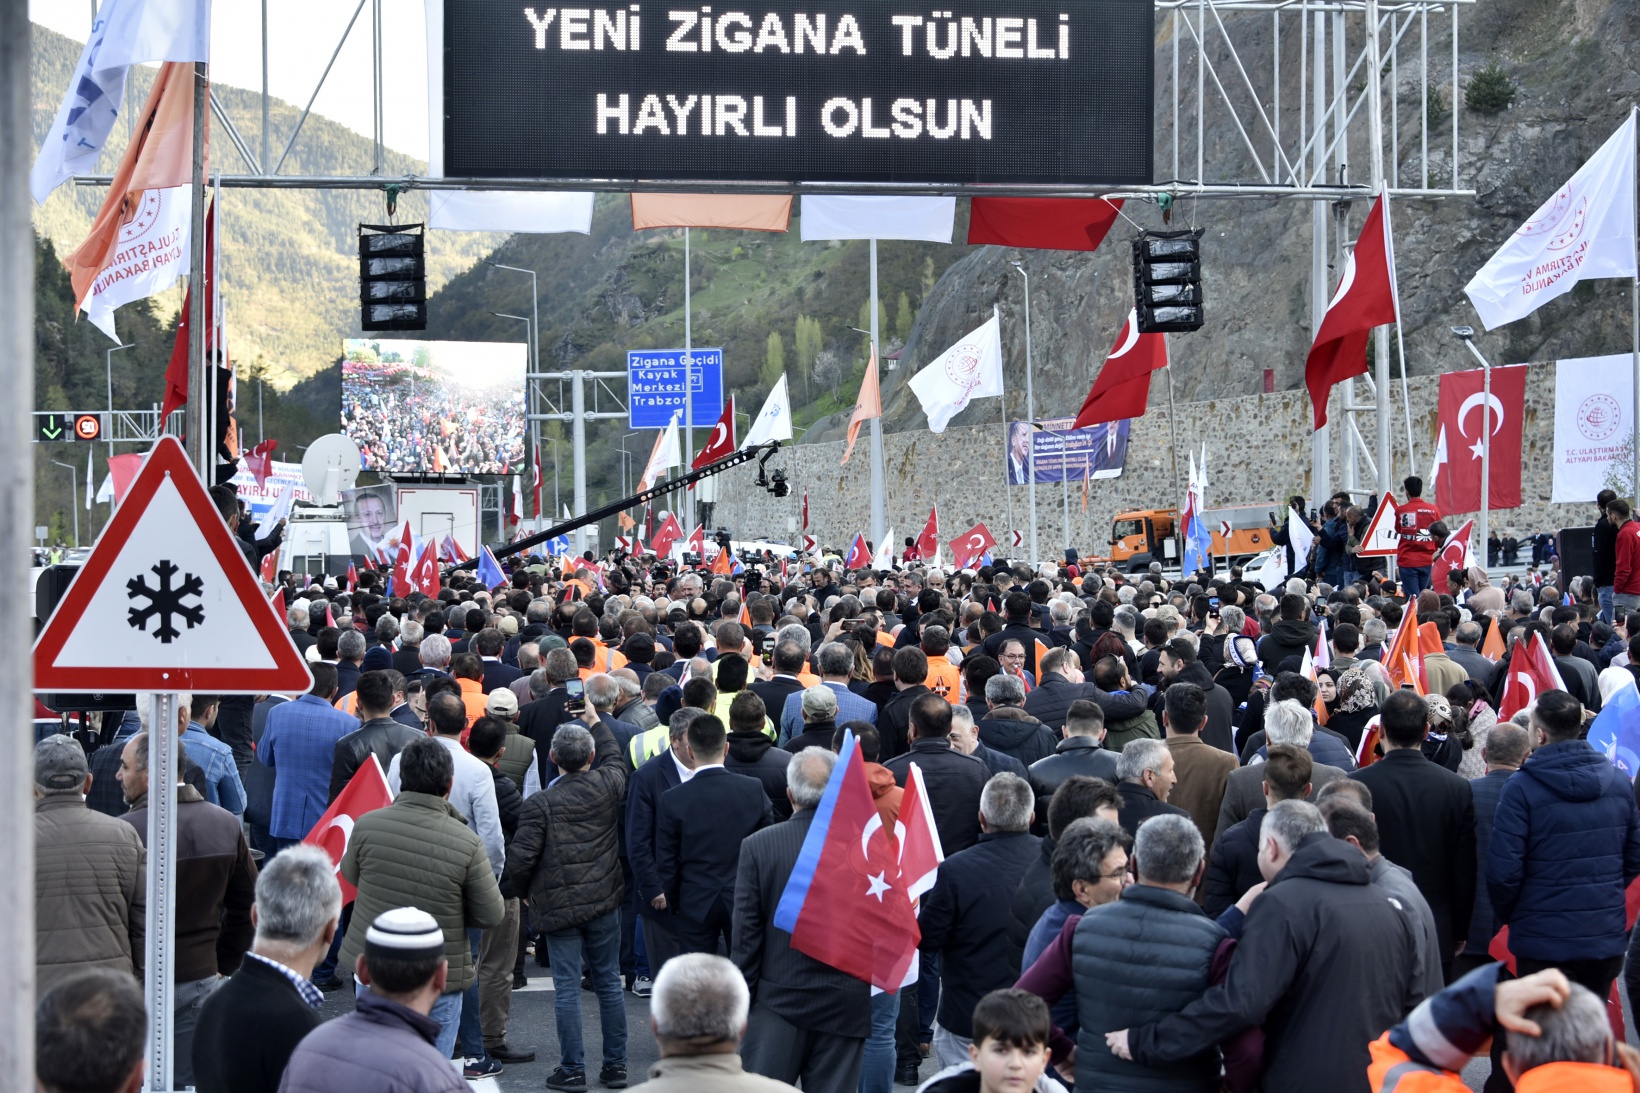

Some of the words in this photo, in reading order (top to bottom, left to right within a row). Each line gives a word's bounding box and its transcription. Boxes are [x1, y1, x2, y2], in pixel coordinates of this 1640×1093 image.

[523, 4, 641, 51] YENİ
[665, 6, 867, 54] ZİGANA
[891, 11, 1070, 59] TÜNELİ
[595, 93, 797, 137] HAYIRLI
[820, 97, 992, 140] OLSUN
[631, 357, 676, 369] Zigana
[679, 354, 719, 367] Geçidi
[638, 369, 678, 381] Kayak
[632, 382, 686, 393] Merkezi
[1043, 420, 1075, 430] MİNNETT
[1565, 456, 1593, 464] ALTYAPI
